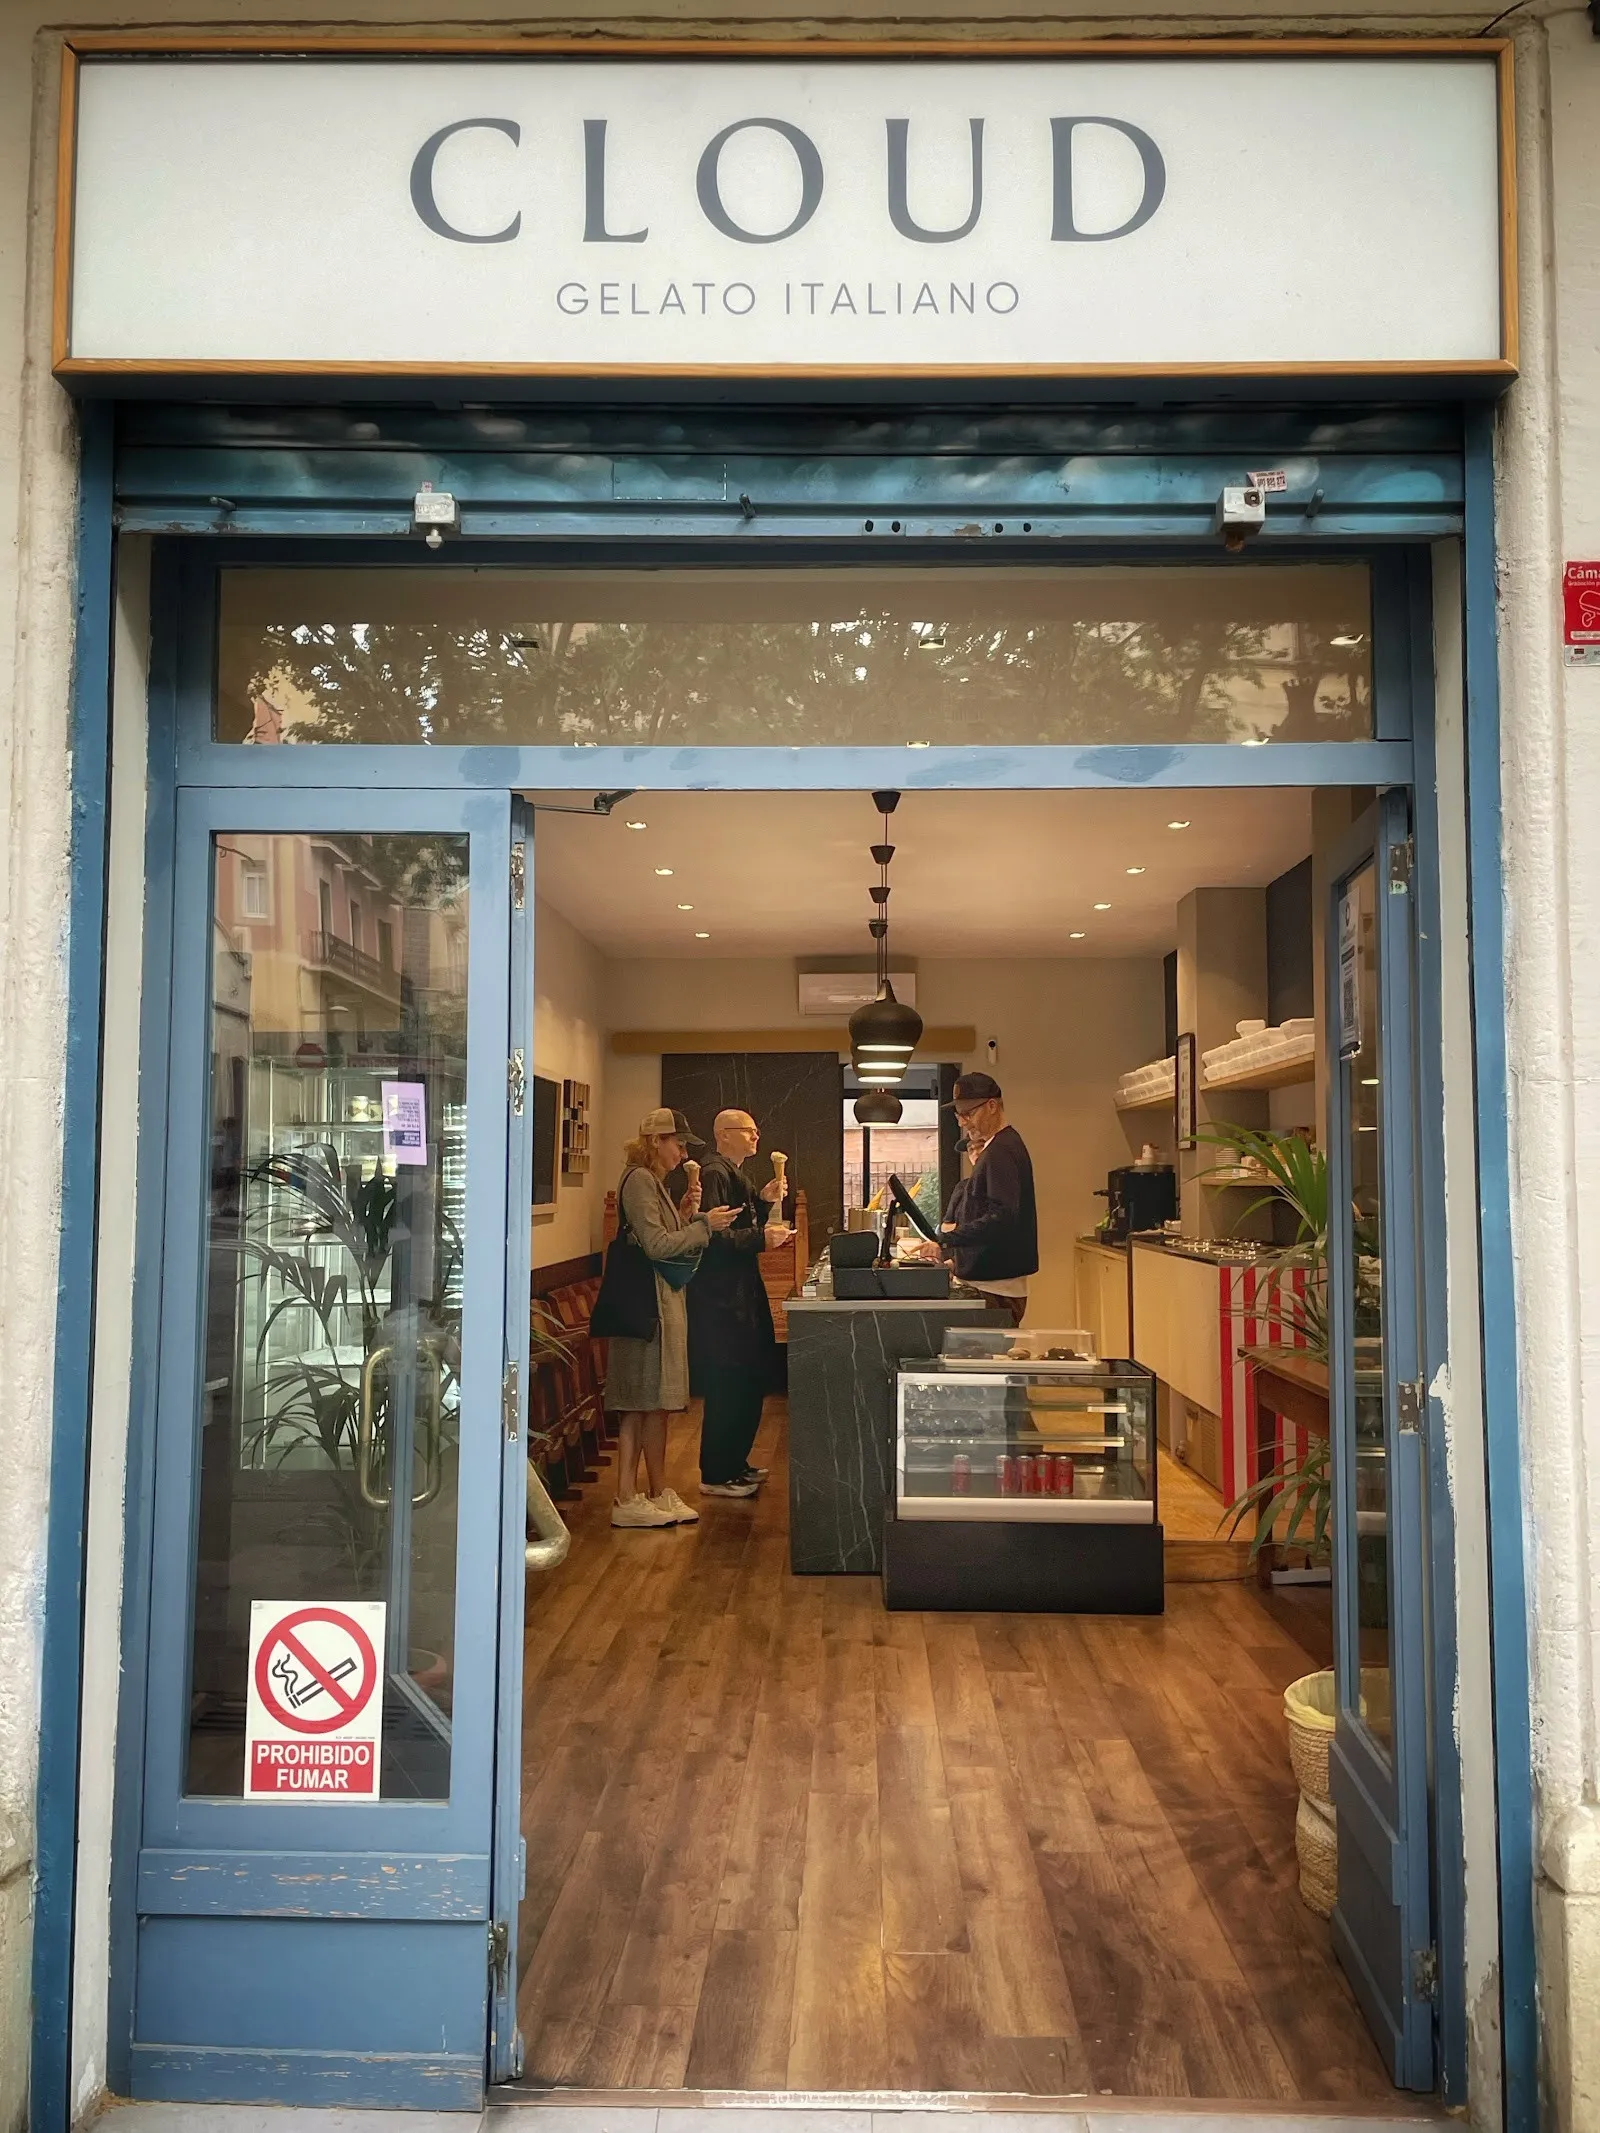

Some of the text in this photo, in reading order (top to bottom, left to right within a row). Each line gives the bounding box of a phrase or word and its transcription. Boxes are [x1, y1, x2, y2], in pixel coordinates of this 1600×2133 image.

[410, 117, 1166, 243] CLOUD
[556, 282, 1019, 315] GELATO ITALIANO
[1567, 565, 1600, 579] Cám
[257, 1744, 370, 1766] PROHIBIDO
[276, 1768, 349, 1789] FUMAR
